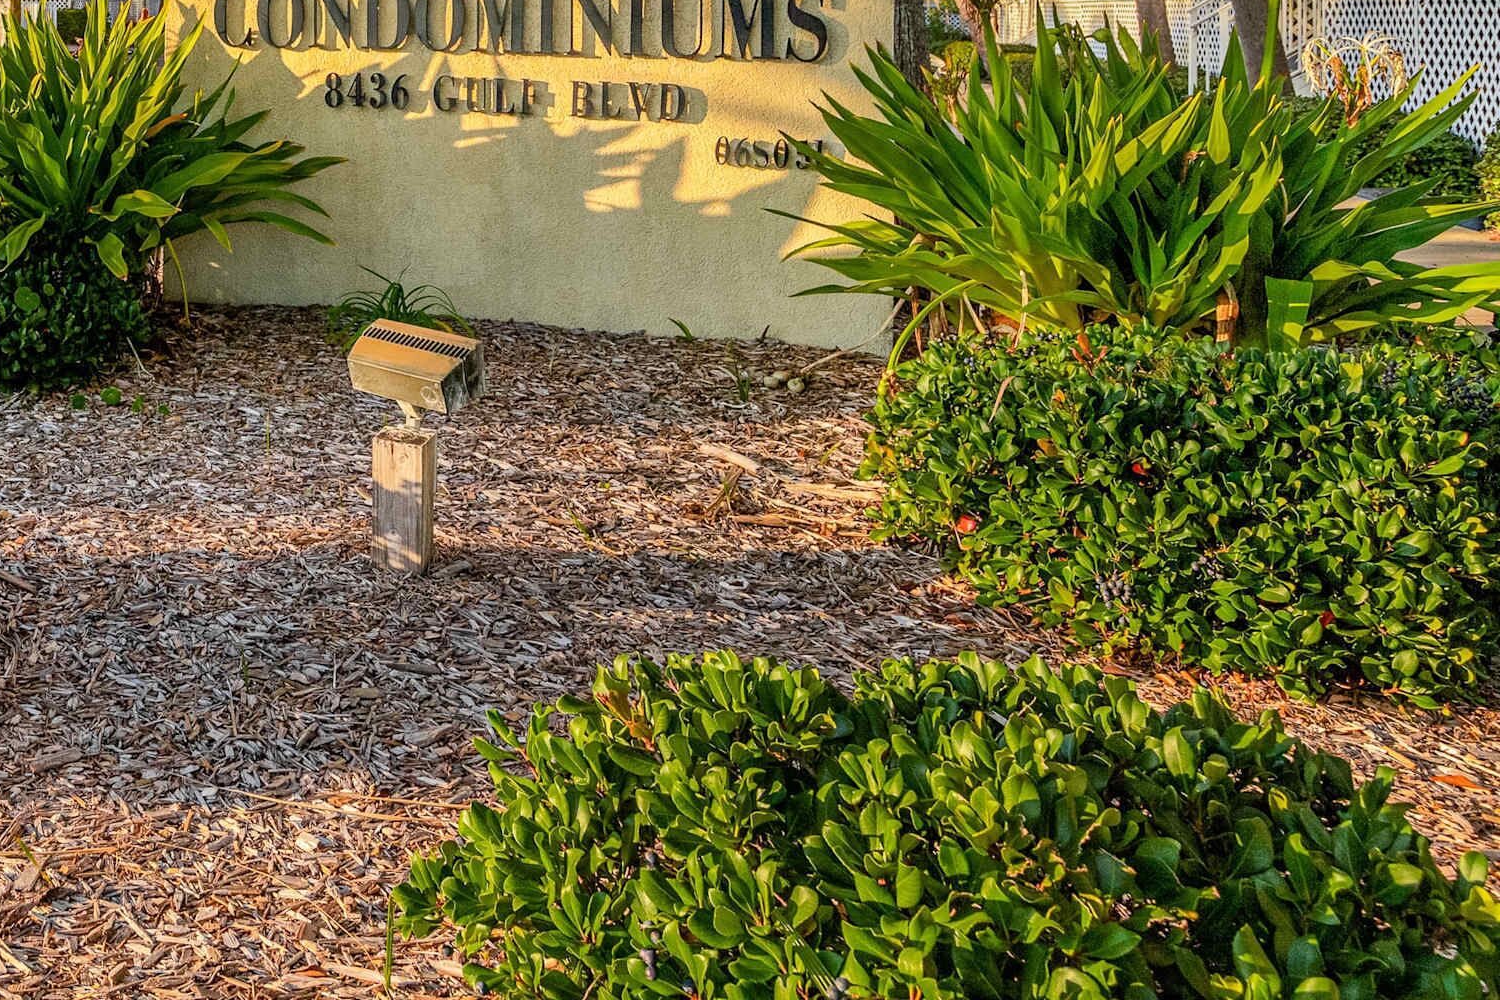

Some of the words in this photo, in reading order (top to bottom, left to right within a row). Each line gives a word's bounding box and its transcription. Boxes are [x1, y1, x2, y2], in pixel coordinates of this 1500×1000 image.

[325, 72, 409, 110] 8436
[434, 75, 536, 116] GULF
[571, 80, 686, 121] BLVD
